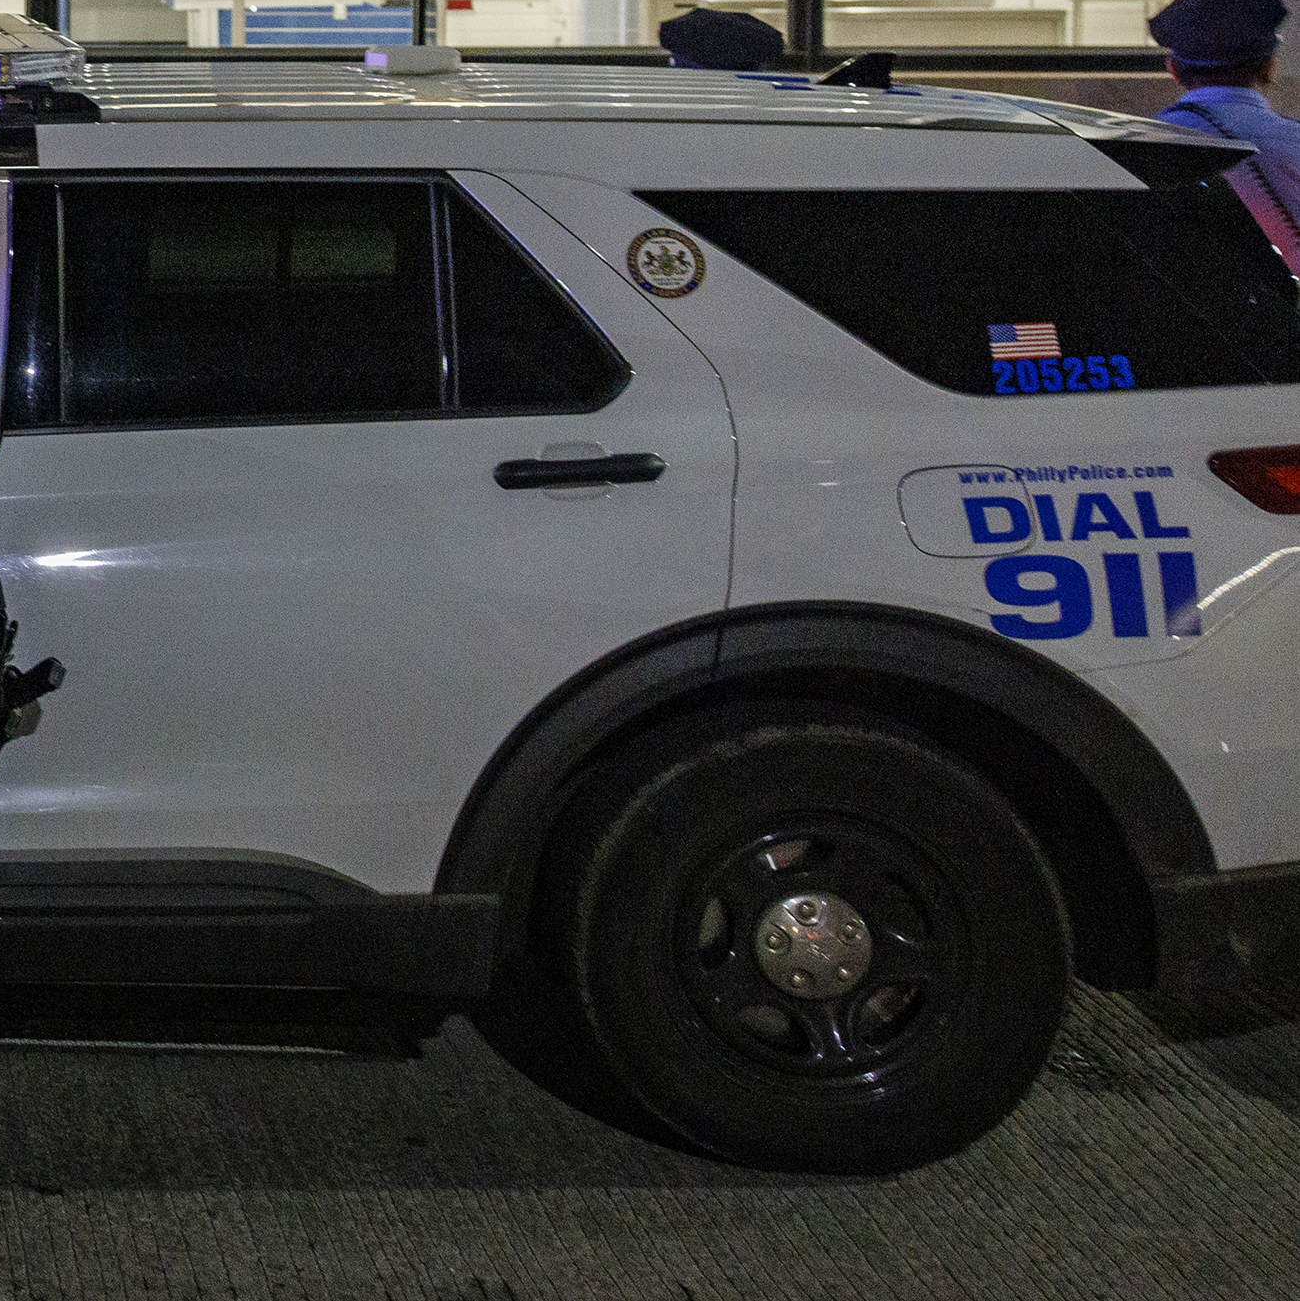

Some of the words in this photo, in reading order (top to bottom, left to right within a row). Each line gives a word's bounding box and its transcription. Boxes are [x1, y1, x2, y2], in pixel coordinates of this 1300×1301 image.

[992, 355, 1135, 394] 205253
[958, 464, 1175, 484] www.PhillyPolice.com
[963, 491, 1191, 544] DIAL
[984, 551, 1201, 640] 911
